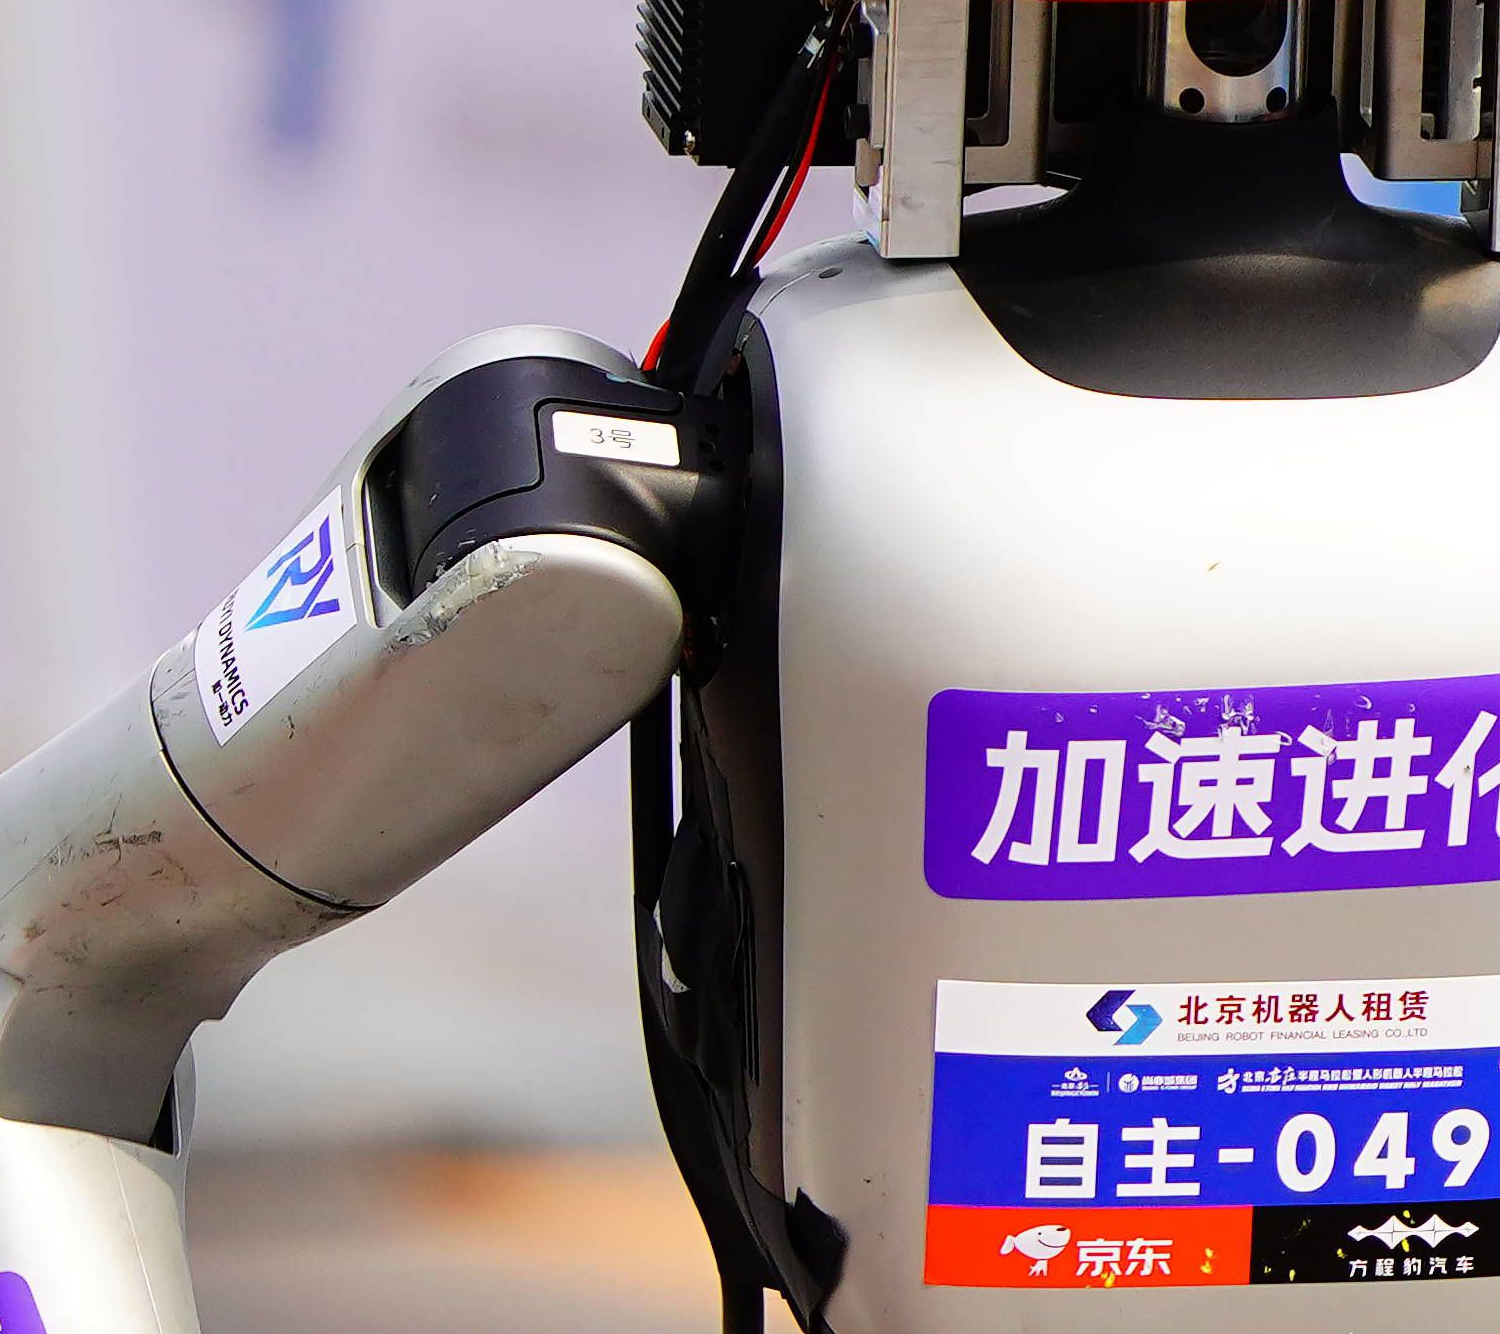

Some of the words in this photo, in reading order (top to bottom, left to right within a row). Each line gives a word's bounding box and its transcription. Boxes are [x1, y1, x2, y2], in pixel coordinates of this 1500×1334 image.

[590, 428, 636, 449] 3号
[218, 621, 249, 716] DYNAMICS
[1178, 990, 1430, 1025] 北京机器人租赁
[1177, 1032, 1220, 1042] BEIJING
[1225, 1031, 1264, 1041] ROBOT
[1270, 1029, 1325, 1040] FINANCIAL
[1332, 1028, 1379, 1039] LEASING
[1024, 1108, 1491, 1199] 自主-049
[1075, 1237, 1173, 1276] 京东
[1349, 1255, 1475, 1278] 方程豹汽车
